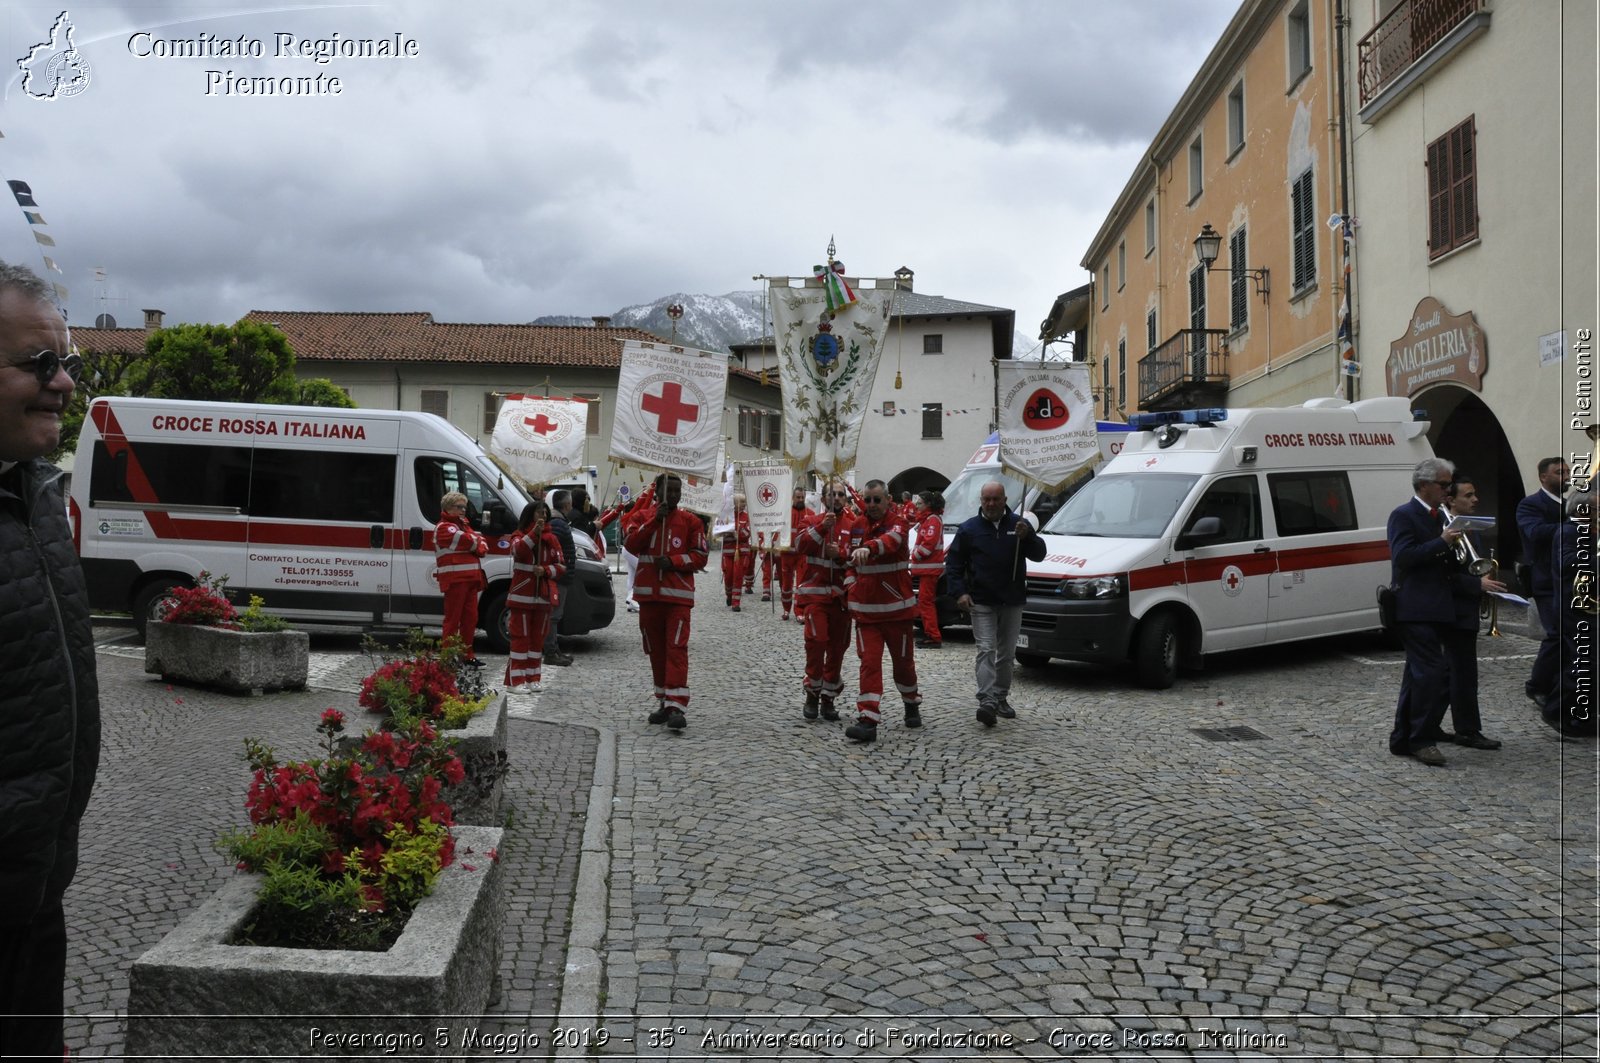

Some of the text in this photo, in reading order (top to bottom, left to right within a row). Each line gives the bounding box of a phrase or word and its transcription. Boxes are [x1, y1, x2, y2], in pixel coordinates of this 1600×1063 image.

[789, 296, 820, 311] COMUNE
[1397, 328, 1468, 374] MACELLERIA
[623, 360, 725, 380] CROCE ROSSA ITALIANA
[681, 360, 691, 368] DEL
[1407, 363, 1456, 395] gastronomia
[152, 415, 366, 440] CROCE ROSSA ITALIANA
[1002, 430, 1096, 446] GRUPPO INTERCOMUNALE
[1264, 432, 1396, 448] CROCE ROSSA ITALIANA
[628, 436, 702, 459] DELEGAZIONE DI
[1003, 447, 1030, 456] BOVES
[1041, 443, 1070, 454] CHIUSA
[1073, 440, 1097, 449] PESIO
[503, 447, 570, 466] SAVIGLIANO
[630, 445, 697, 468] PEVERAGNO
[1026, 453, 1077, 467] PEVERAGNO
[249, 553, 388, 568] COMITATO LOCALE PEVERAGNO
[281, 566, 354, 577] TEL.0171.339555
